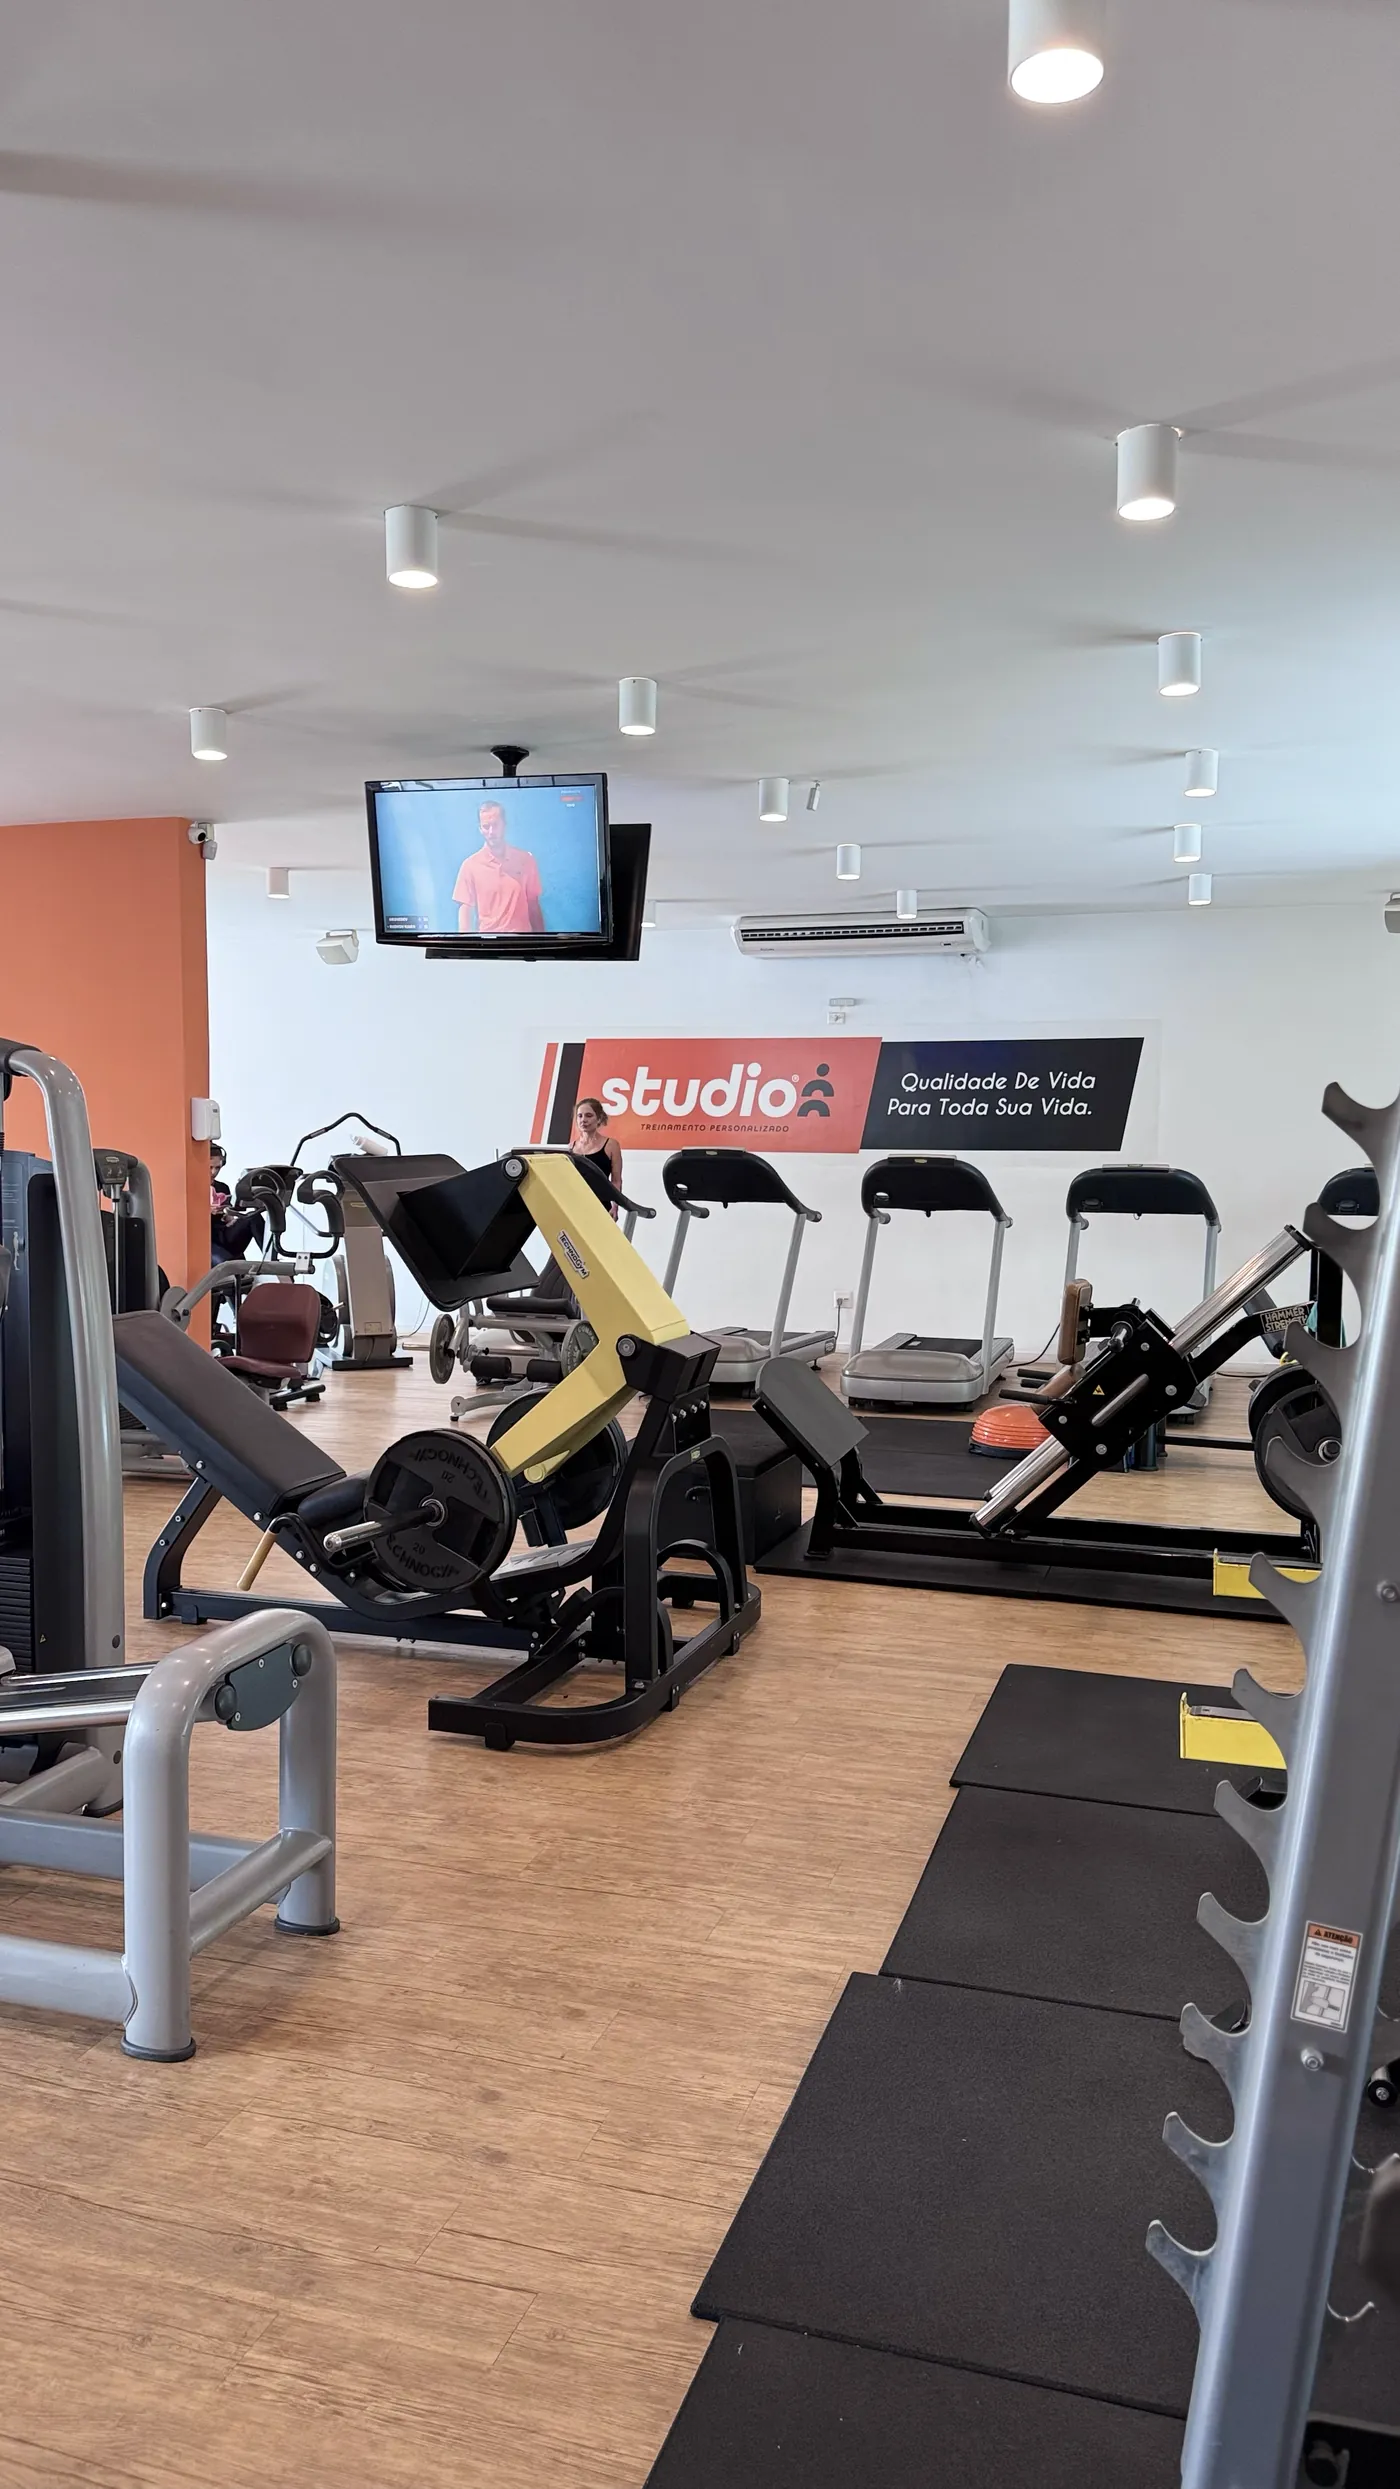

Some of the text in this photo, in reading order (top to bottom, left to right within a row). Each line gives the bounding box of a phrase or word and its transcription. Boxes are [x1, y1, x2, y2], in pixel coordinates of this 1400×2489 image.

[901, 1071, 1096, 1092] Qualidade De Vida
[887, 1097, 1093, 1116] Para Toda Sua Vida.
[640, 1123, 790, 1133] TREINAMENTO PERSONALIZADO
[1264, 1306, 1305, 1323] HAMMER
[1265, 1315, 1308, 1332] STRETH
[413, 1541, 426, 1556] 20
